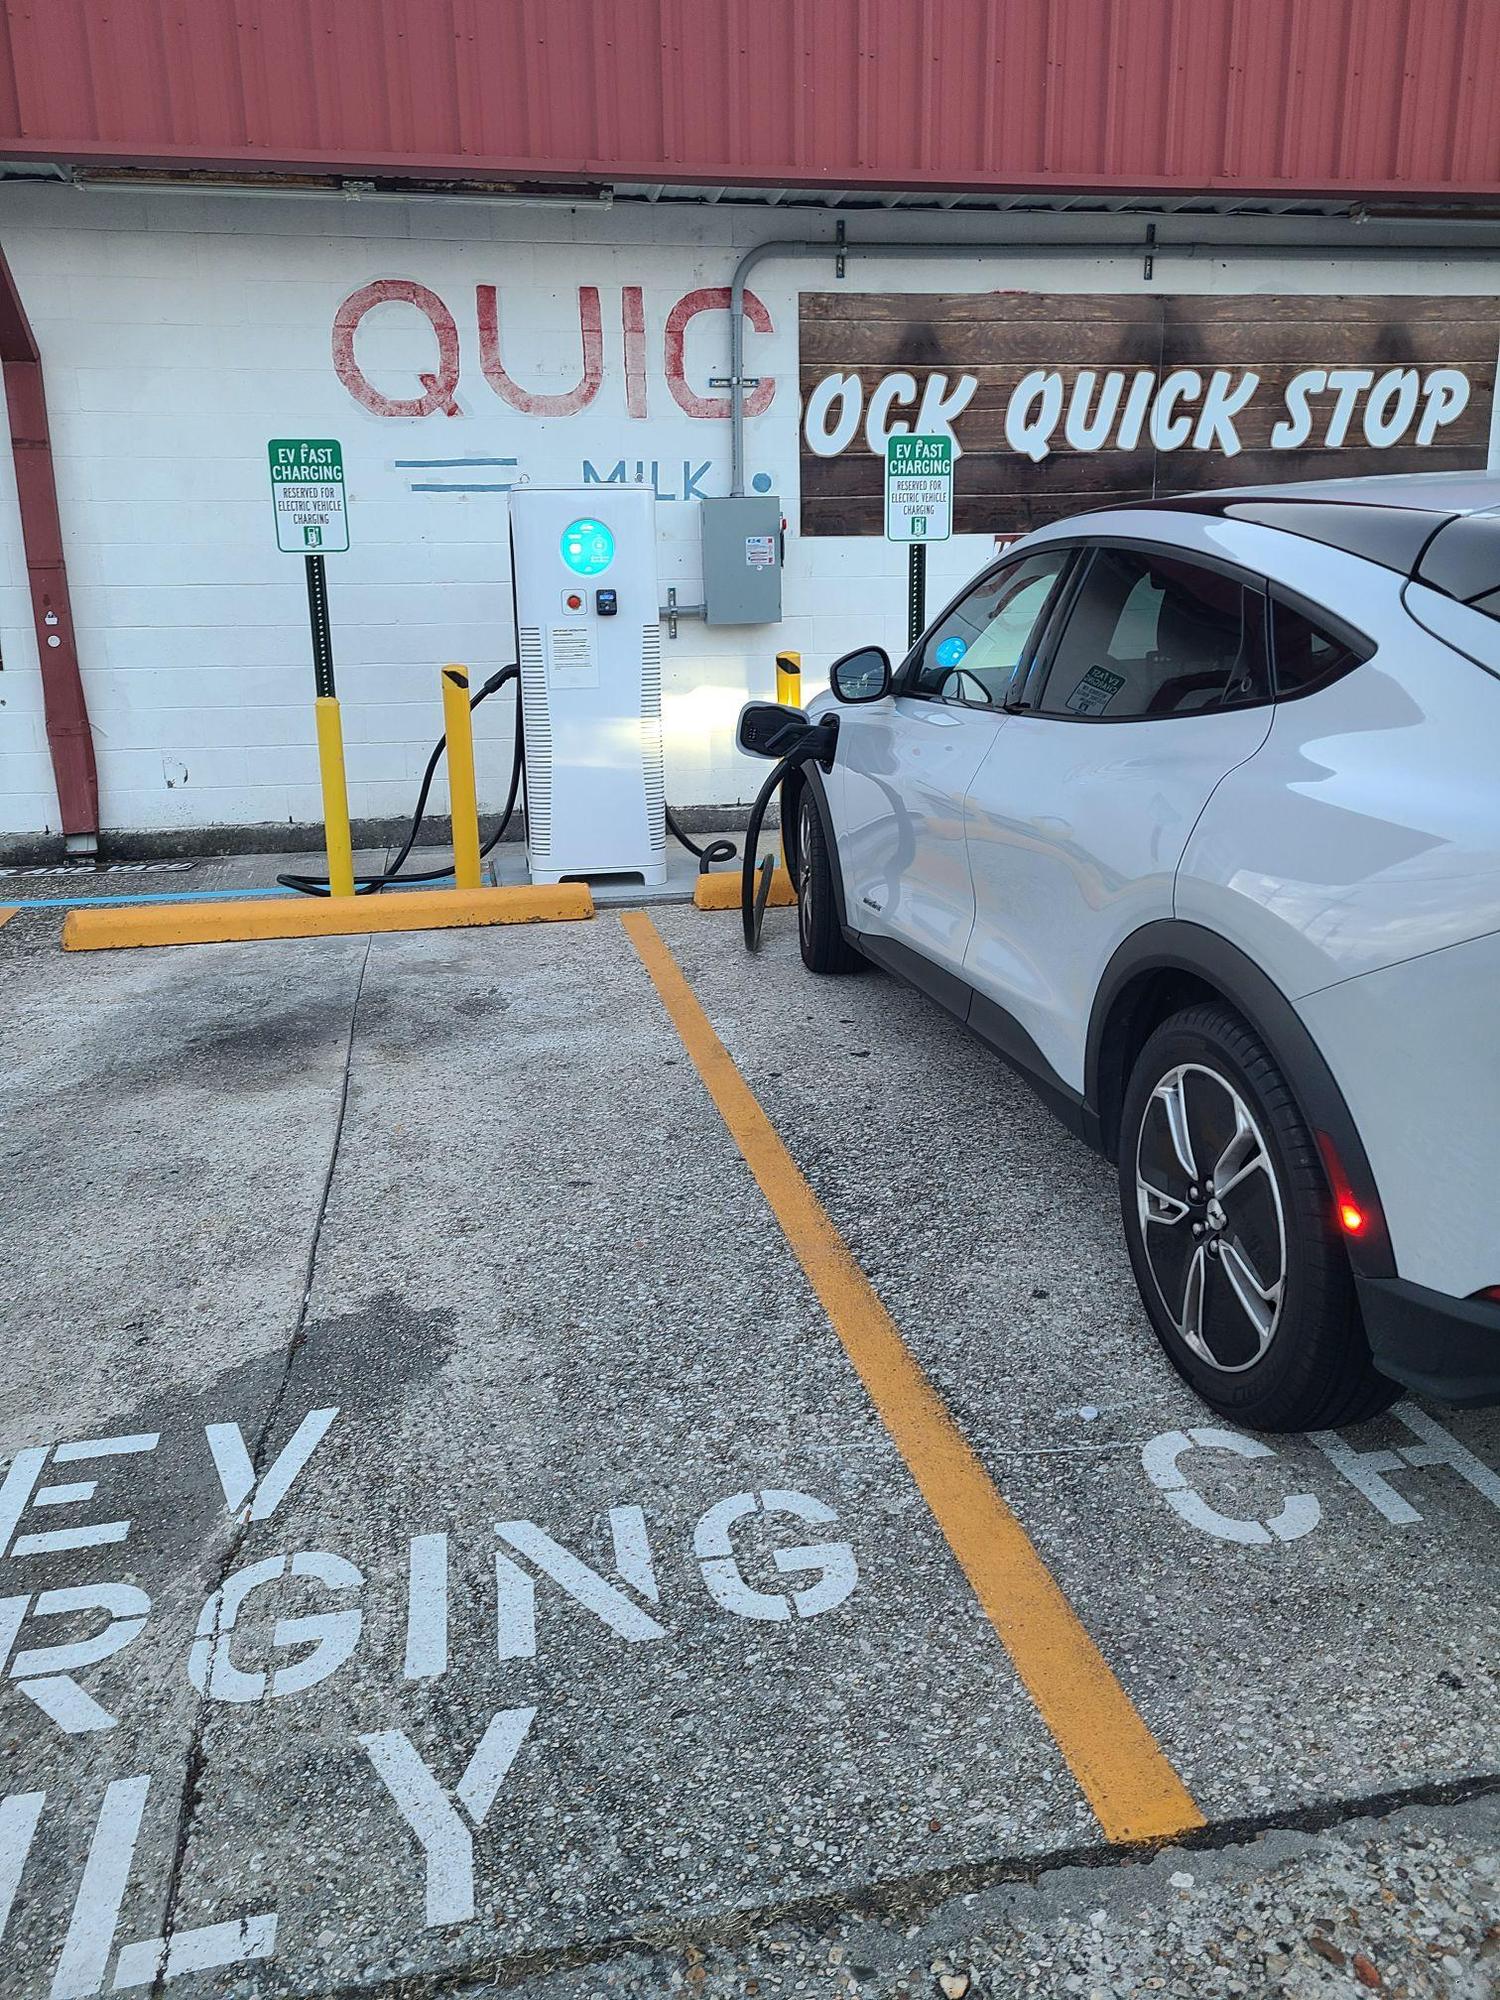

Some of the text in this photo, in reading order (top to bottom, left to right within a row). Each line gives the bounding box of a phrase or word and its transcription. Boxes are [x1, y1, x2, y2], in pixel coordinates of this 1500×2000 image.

[332, 279, 776, 419] QUIC
[1004, 369, 1260, 462] QUICK
[1271, 367, 1471, 450] STOP
[278, 448, 333, 464] EV FAST
[896, 444, 945, 459] EV FAST
[272, 465, 343, 481] CHARGING
[889, 459, 951, 475] CHARGING
[282, 487, 336, 499] RESERVED FOR
[896, 480, 942, 491] RESERVED FOR
[891, 492, 947, 503] ELECTRIC VEHICLE
[278, 500, 343, 512] ELECTRIC VEHICLE
[903, 505, 935, 516] CHARGING
[293, 513, 330, 525] CHARGING
[0, 1407, 341, 1557] EV
